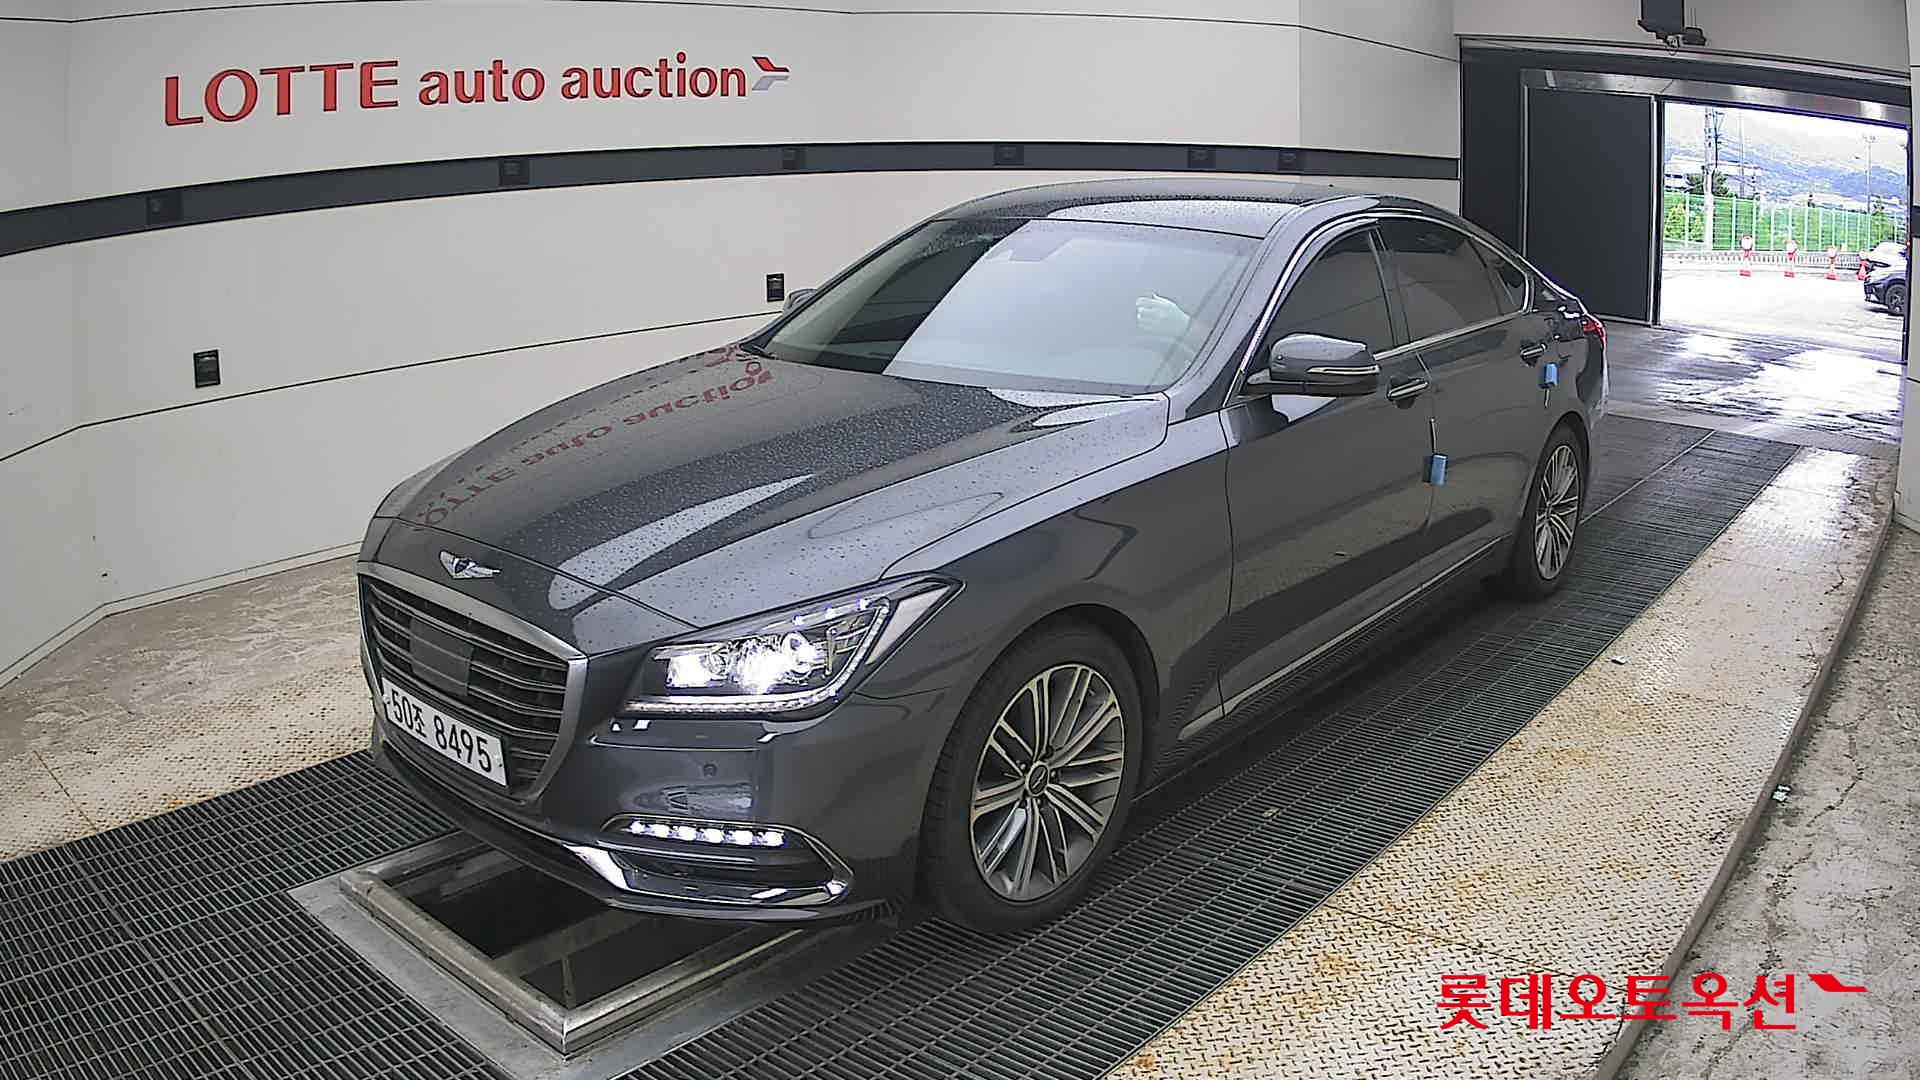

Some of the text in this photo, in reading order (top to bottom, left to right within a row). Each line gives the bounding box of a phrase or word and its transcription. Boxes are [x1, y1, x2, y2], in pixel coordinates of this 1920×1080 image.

[164, 50, 747, 127] LOTTE auto auction
[391, 687, 493, 774] 50조 8495
